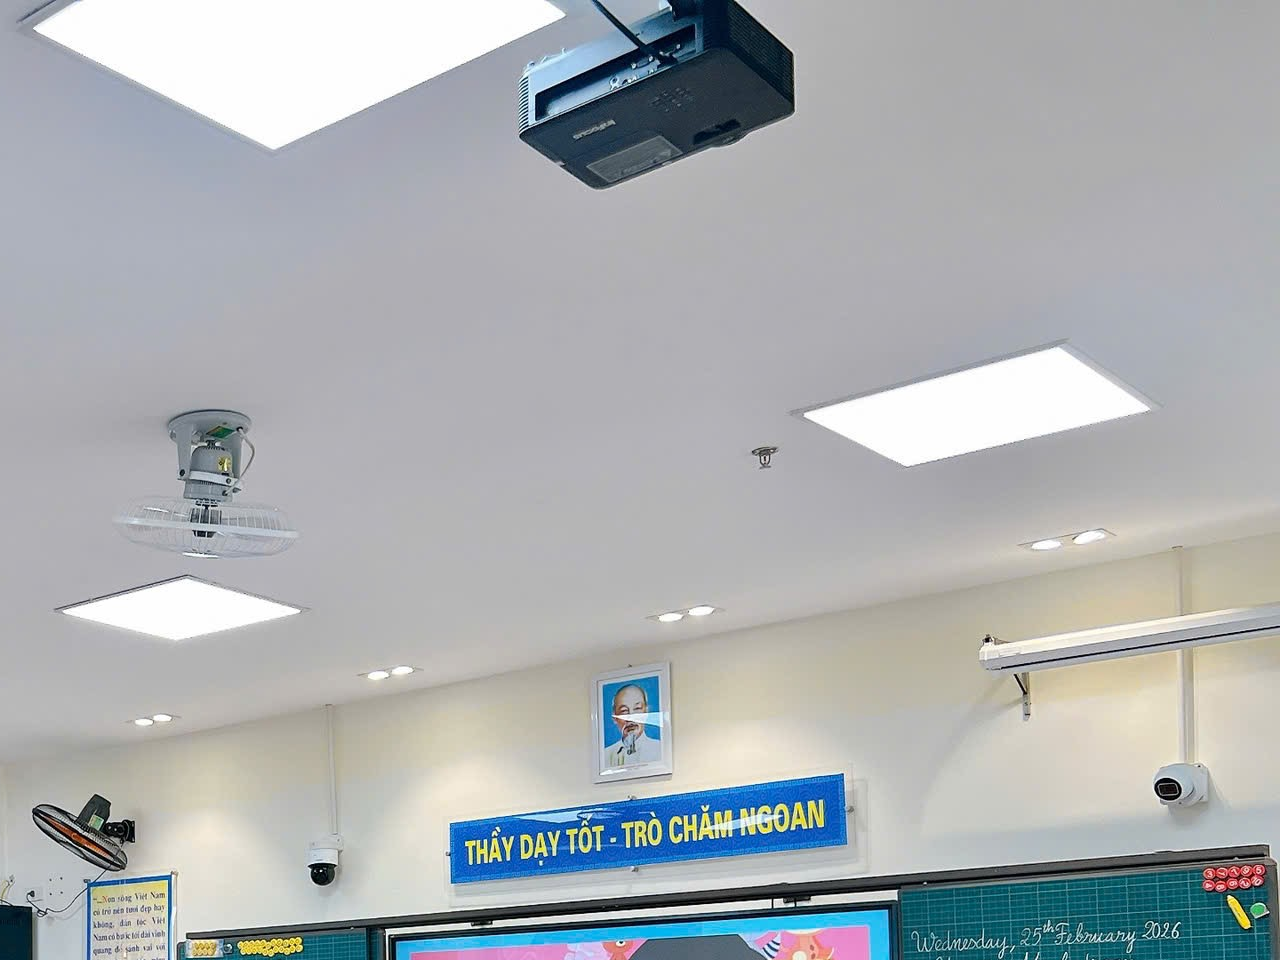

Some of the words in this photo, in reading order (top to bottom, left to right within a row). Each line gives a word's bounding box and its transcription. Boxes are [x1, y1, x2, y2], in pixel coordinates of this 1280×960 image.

[465, 826, 513, 866] THẦY
[520, 830, 559, 866] DẠY
[566, 814, 604, 855] TỐT
[621, 813, 663, 849] TRÒ
[669, 805, 733, 843] CHĂM
[739, 799, 825, 836] NGOAN
[151, 891, 166, 899] Nam
[153, 904, 165, 912] hay
[93, 933, 107, 941] Nam
[911, 930, 1016, 959] Wednesday,
[1053, 923, 1137, 955] February
[1142, 921, 1182, 941] 2026
